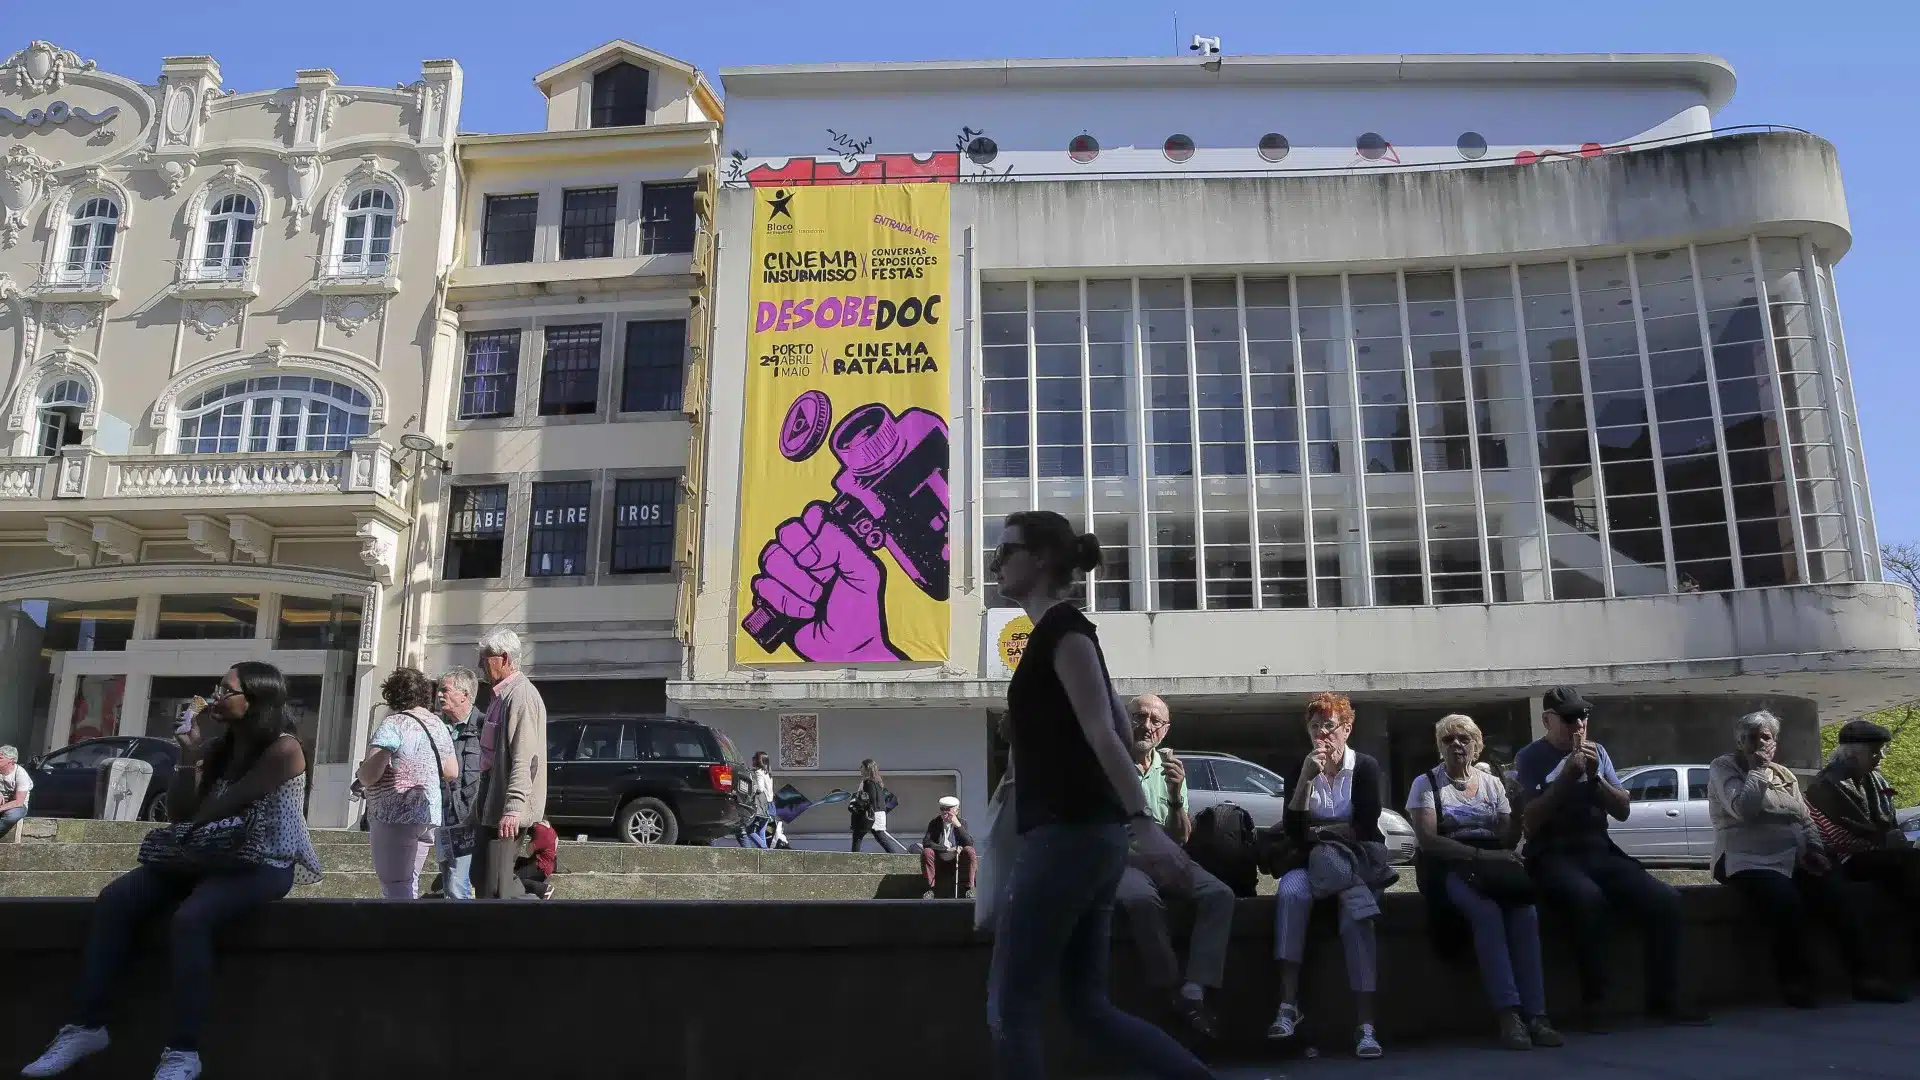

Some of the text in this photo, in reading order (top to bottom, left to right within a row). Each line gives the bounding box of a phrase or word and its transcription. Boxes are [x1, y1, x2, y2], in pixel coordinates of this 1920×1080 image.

[767, 223, 793, 231] Bloco
[873, 214, 940, 244] ENTRADA LIVRE
[871, 247, 927, 256] CONVERSAS
[763, 250, 857, 270] CINEMA
[763, 268, 857, 283] INSUBMISSO
[871, 267, 924, 280] FESTAS
[755, 295, 941, 333] DESOBEDOC
[772, 343, 814, 356] PORTO
[844, 342, 929, 357] CINEMA
[760, 355, 813, 366] 29 ABRIL
[833, 357, 938, 375] BATALHA
[781, 367, 810, 377] MAIO
[534, 506, 588, 526] LEIRE
[620, 504, 661, 522] IROS
